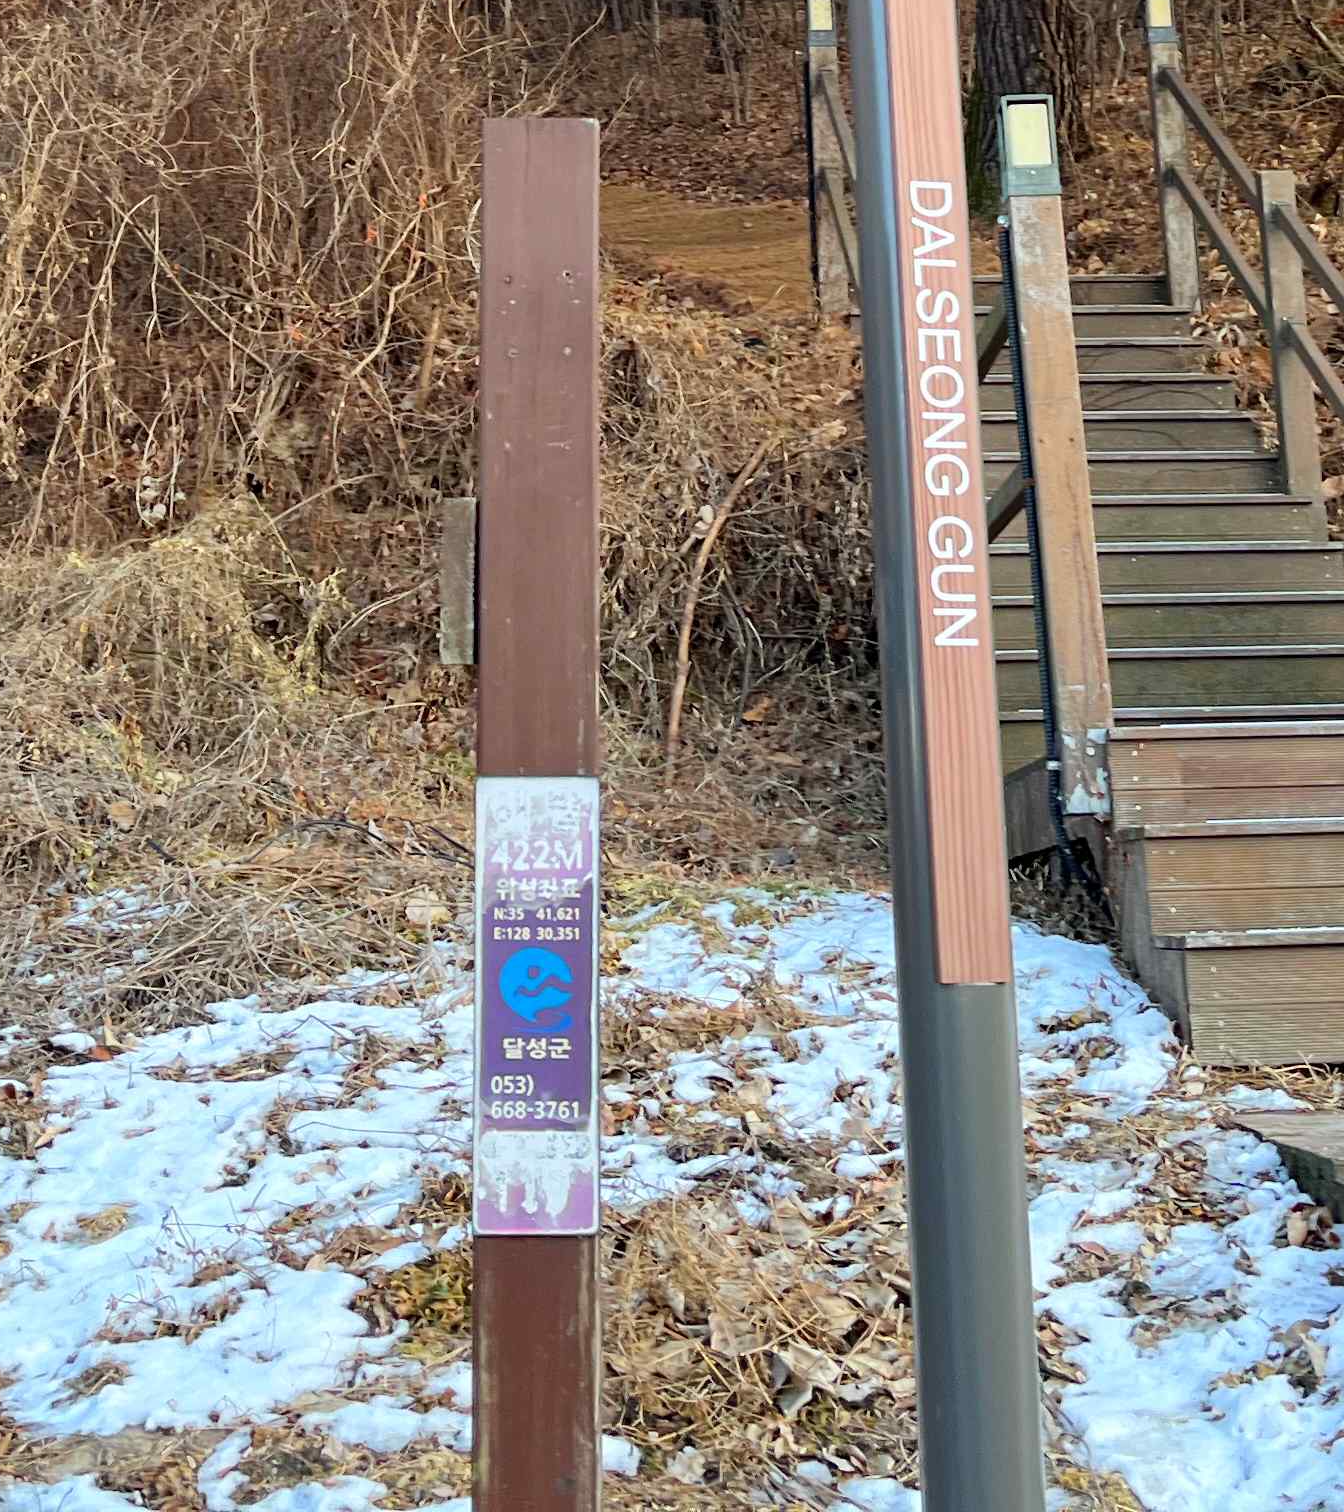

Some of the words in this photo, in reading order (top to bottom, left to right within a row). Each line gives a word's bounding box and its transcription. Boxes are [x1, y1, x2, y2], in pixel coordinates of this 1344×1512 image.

[909, 180, 970, 498] DALSEONG
[927, 515, 979, 648] GUN
[496, 877, 581, 901] 위성좌표
[494, 907, 525, 920] N:35
[494, 927, 530, 940] E:128
[502, 1038, 573, 1059] 달성군
[490, 1075, 535, 1096] 053)
[490, 1100, 581, 1120] 668-3761
